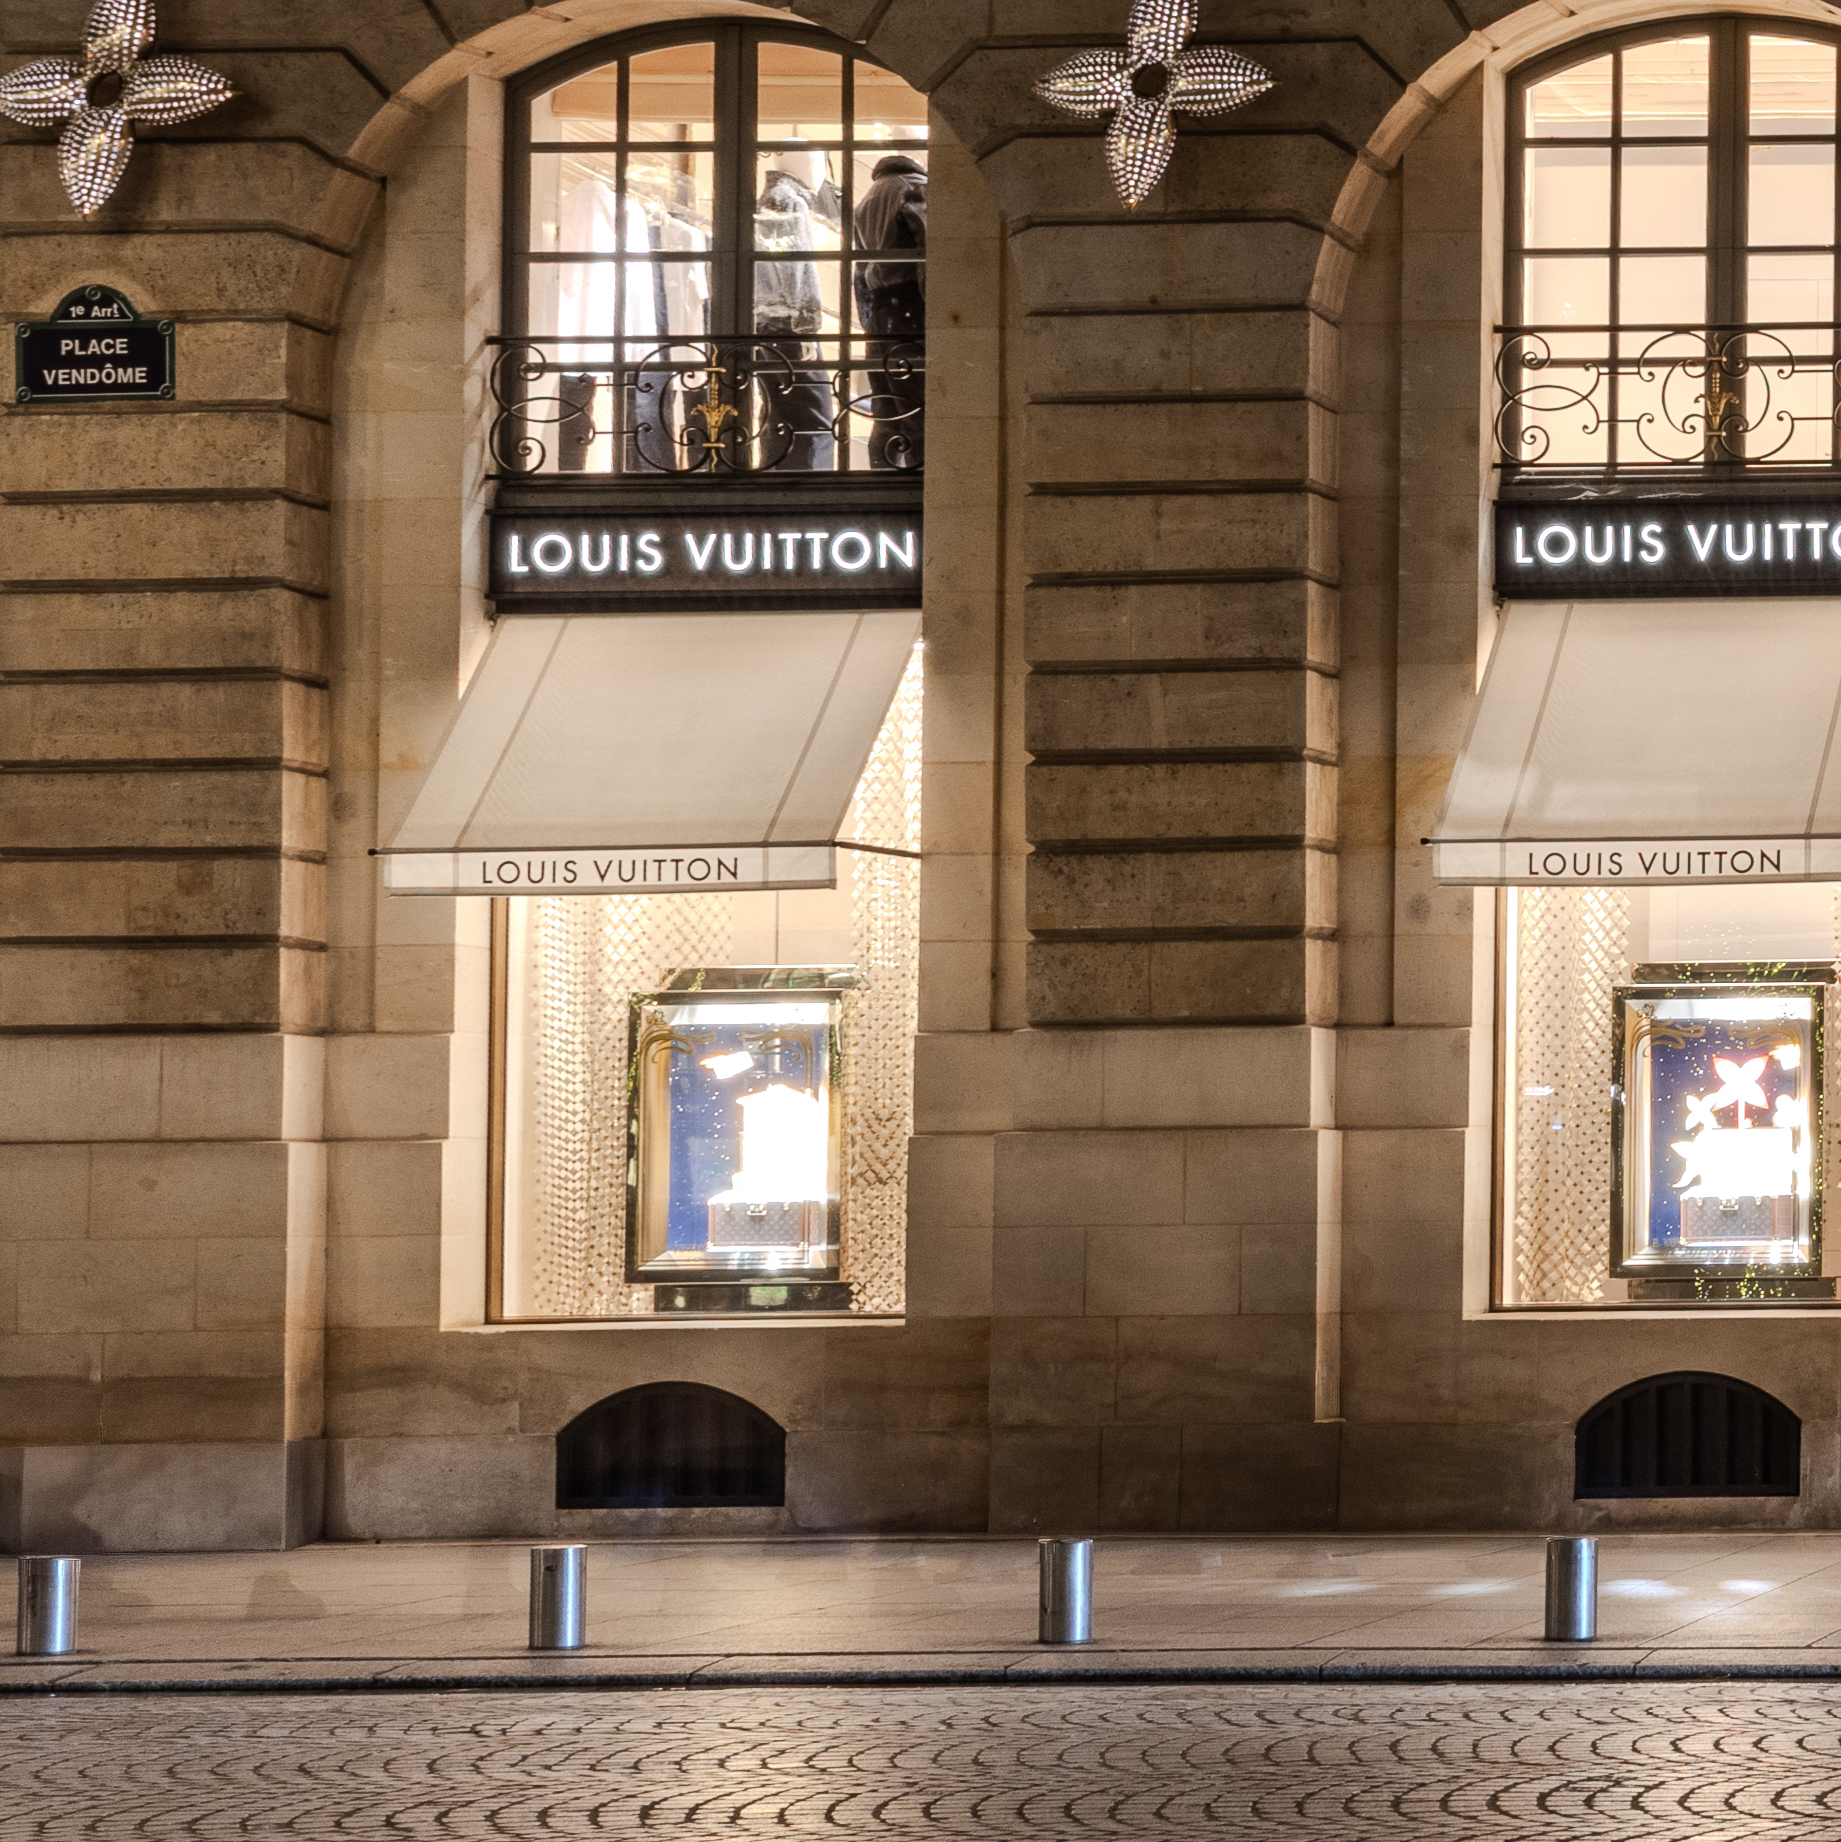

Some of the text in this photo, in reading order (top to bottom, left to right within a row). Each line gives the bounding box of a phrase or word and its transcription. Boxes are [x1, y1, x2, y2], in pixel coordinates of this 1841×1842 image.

[60, 338, 129, 356] PLACE
[43, 363, 148, 385] VENDÔME
[508, 531, 915, 574] LOUIS VUITTON
[1514, 523, 1666, 565] LOUIS
[482, 857, 738, 884] LOUIS VUITTON
[1529, 849, 1781, 876] LOUIS VUITTON
